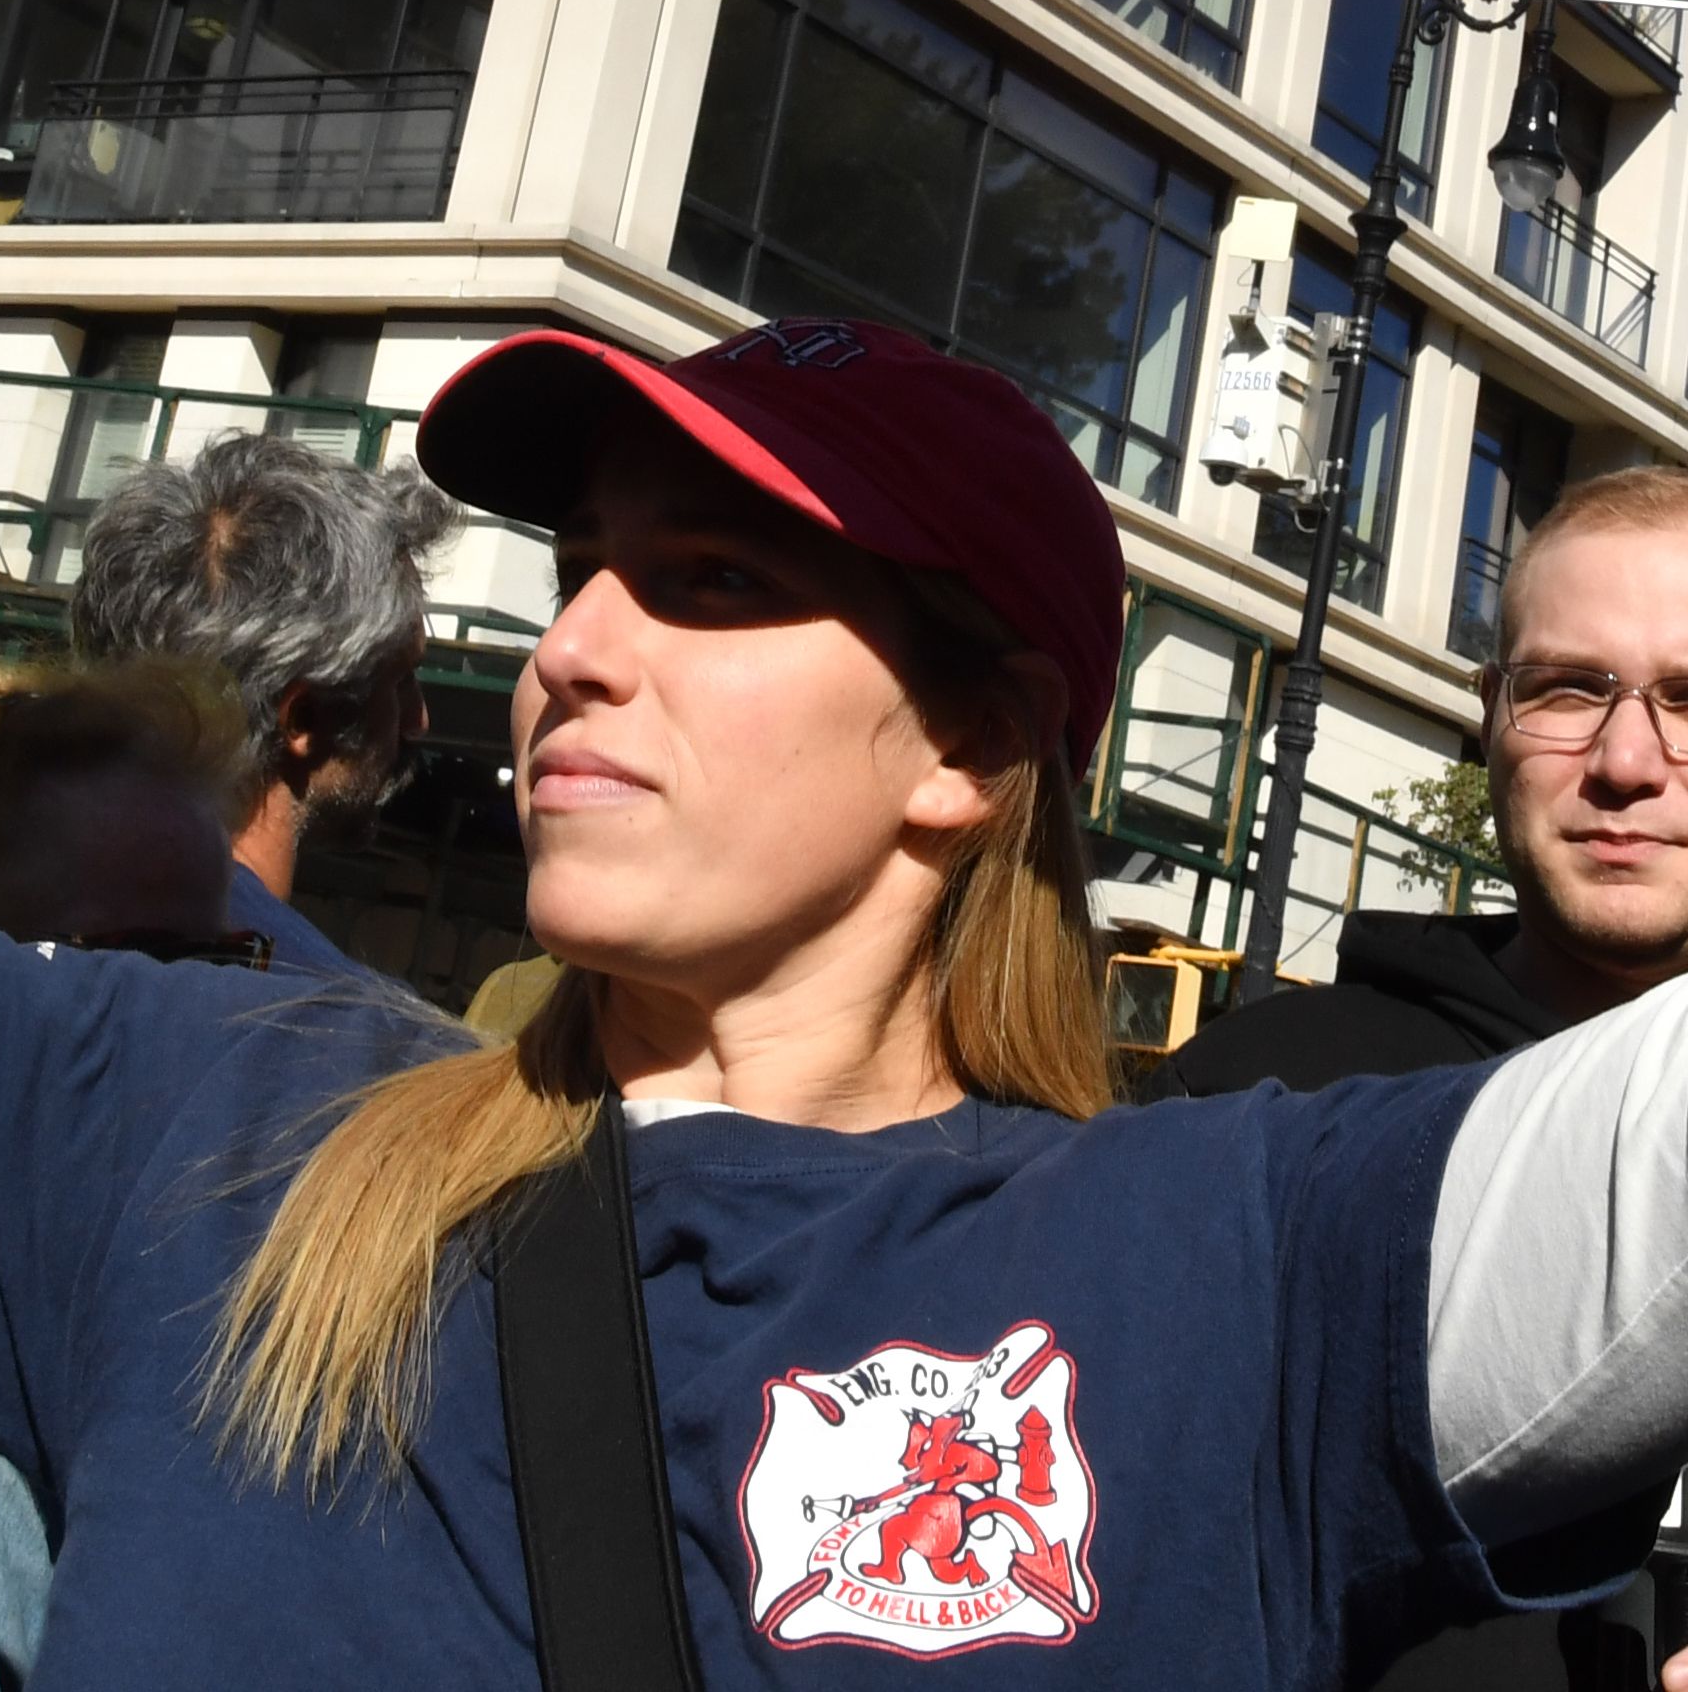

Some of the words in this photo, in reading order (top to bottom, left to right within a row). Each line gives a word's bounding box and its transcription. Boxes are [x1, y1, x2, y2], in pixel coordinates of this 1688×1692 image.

[1223, 370, 1272, 391] 72566
[828, 1361, 900, 1407] ENG.
[912, 1363, 954, 1399] CO.
[813, 1515, 863, 1563] FDNY
[835, 1579, 863, 1607] TO
[869, 1591, 931, 1625] HELL
[937, 1601, 955, 1625] &
[957, 1583, 1021, 1624] BACK
